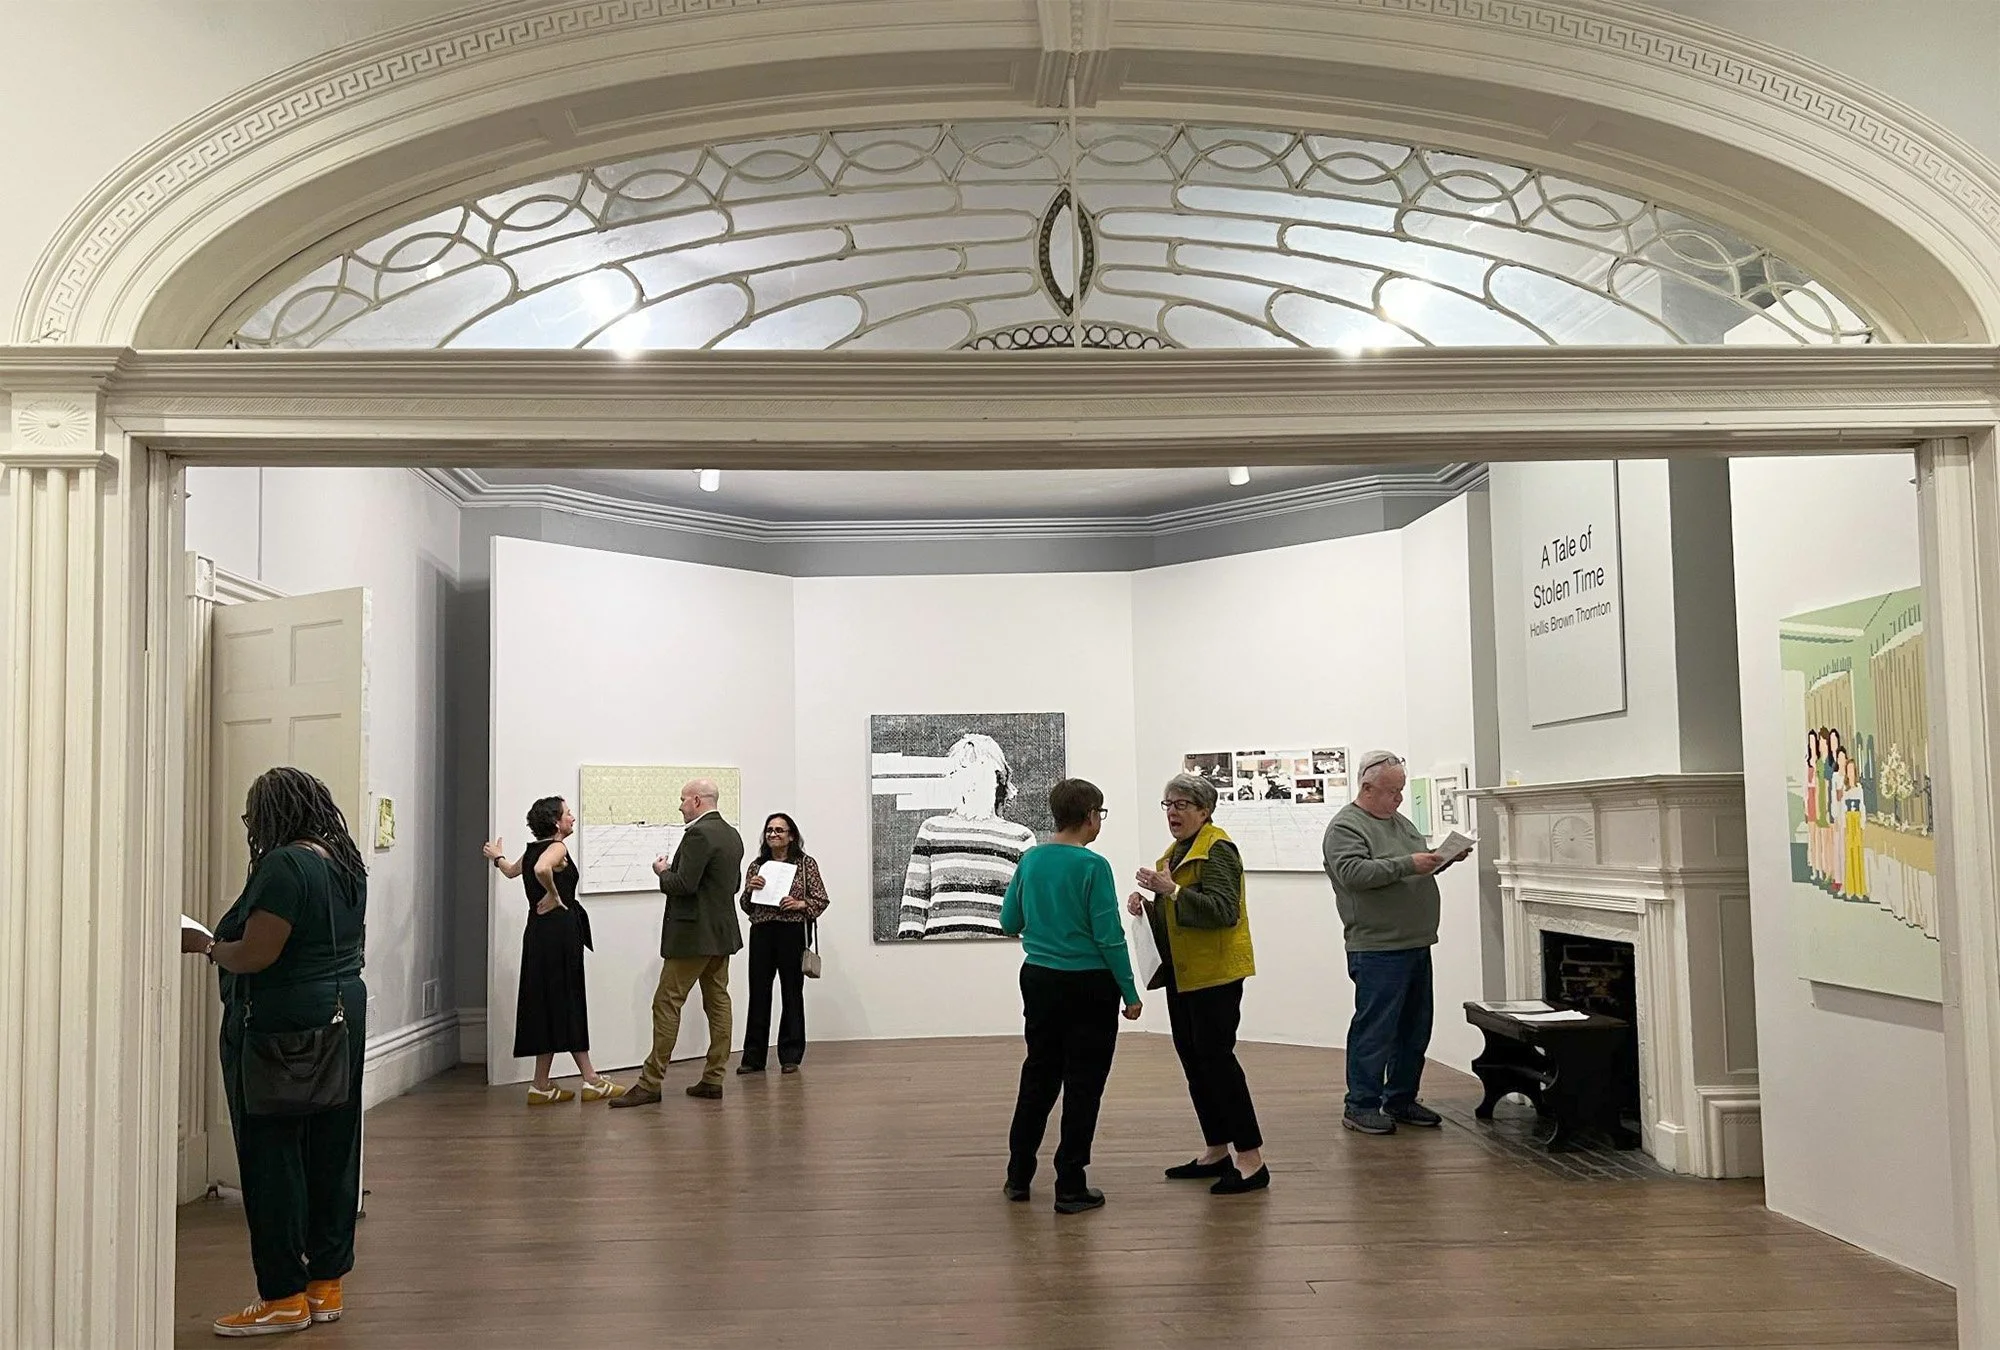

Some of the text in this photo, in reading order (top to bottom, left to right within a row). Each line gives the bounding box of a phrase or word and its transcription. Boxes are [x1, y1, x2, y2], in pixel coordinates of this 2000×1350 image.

[1541, 524, 1592, 569] A Tale of
[1533, 567, 1604, 609] Stolen Time
[1529, 601, 1611, 638] Hollis Brown Thornton
